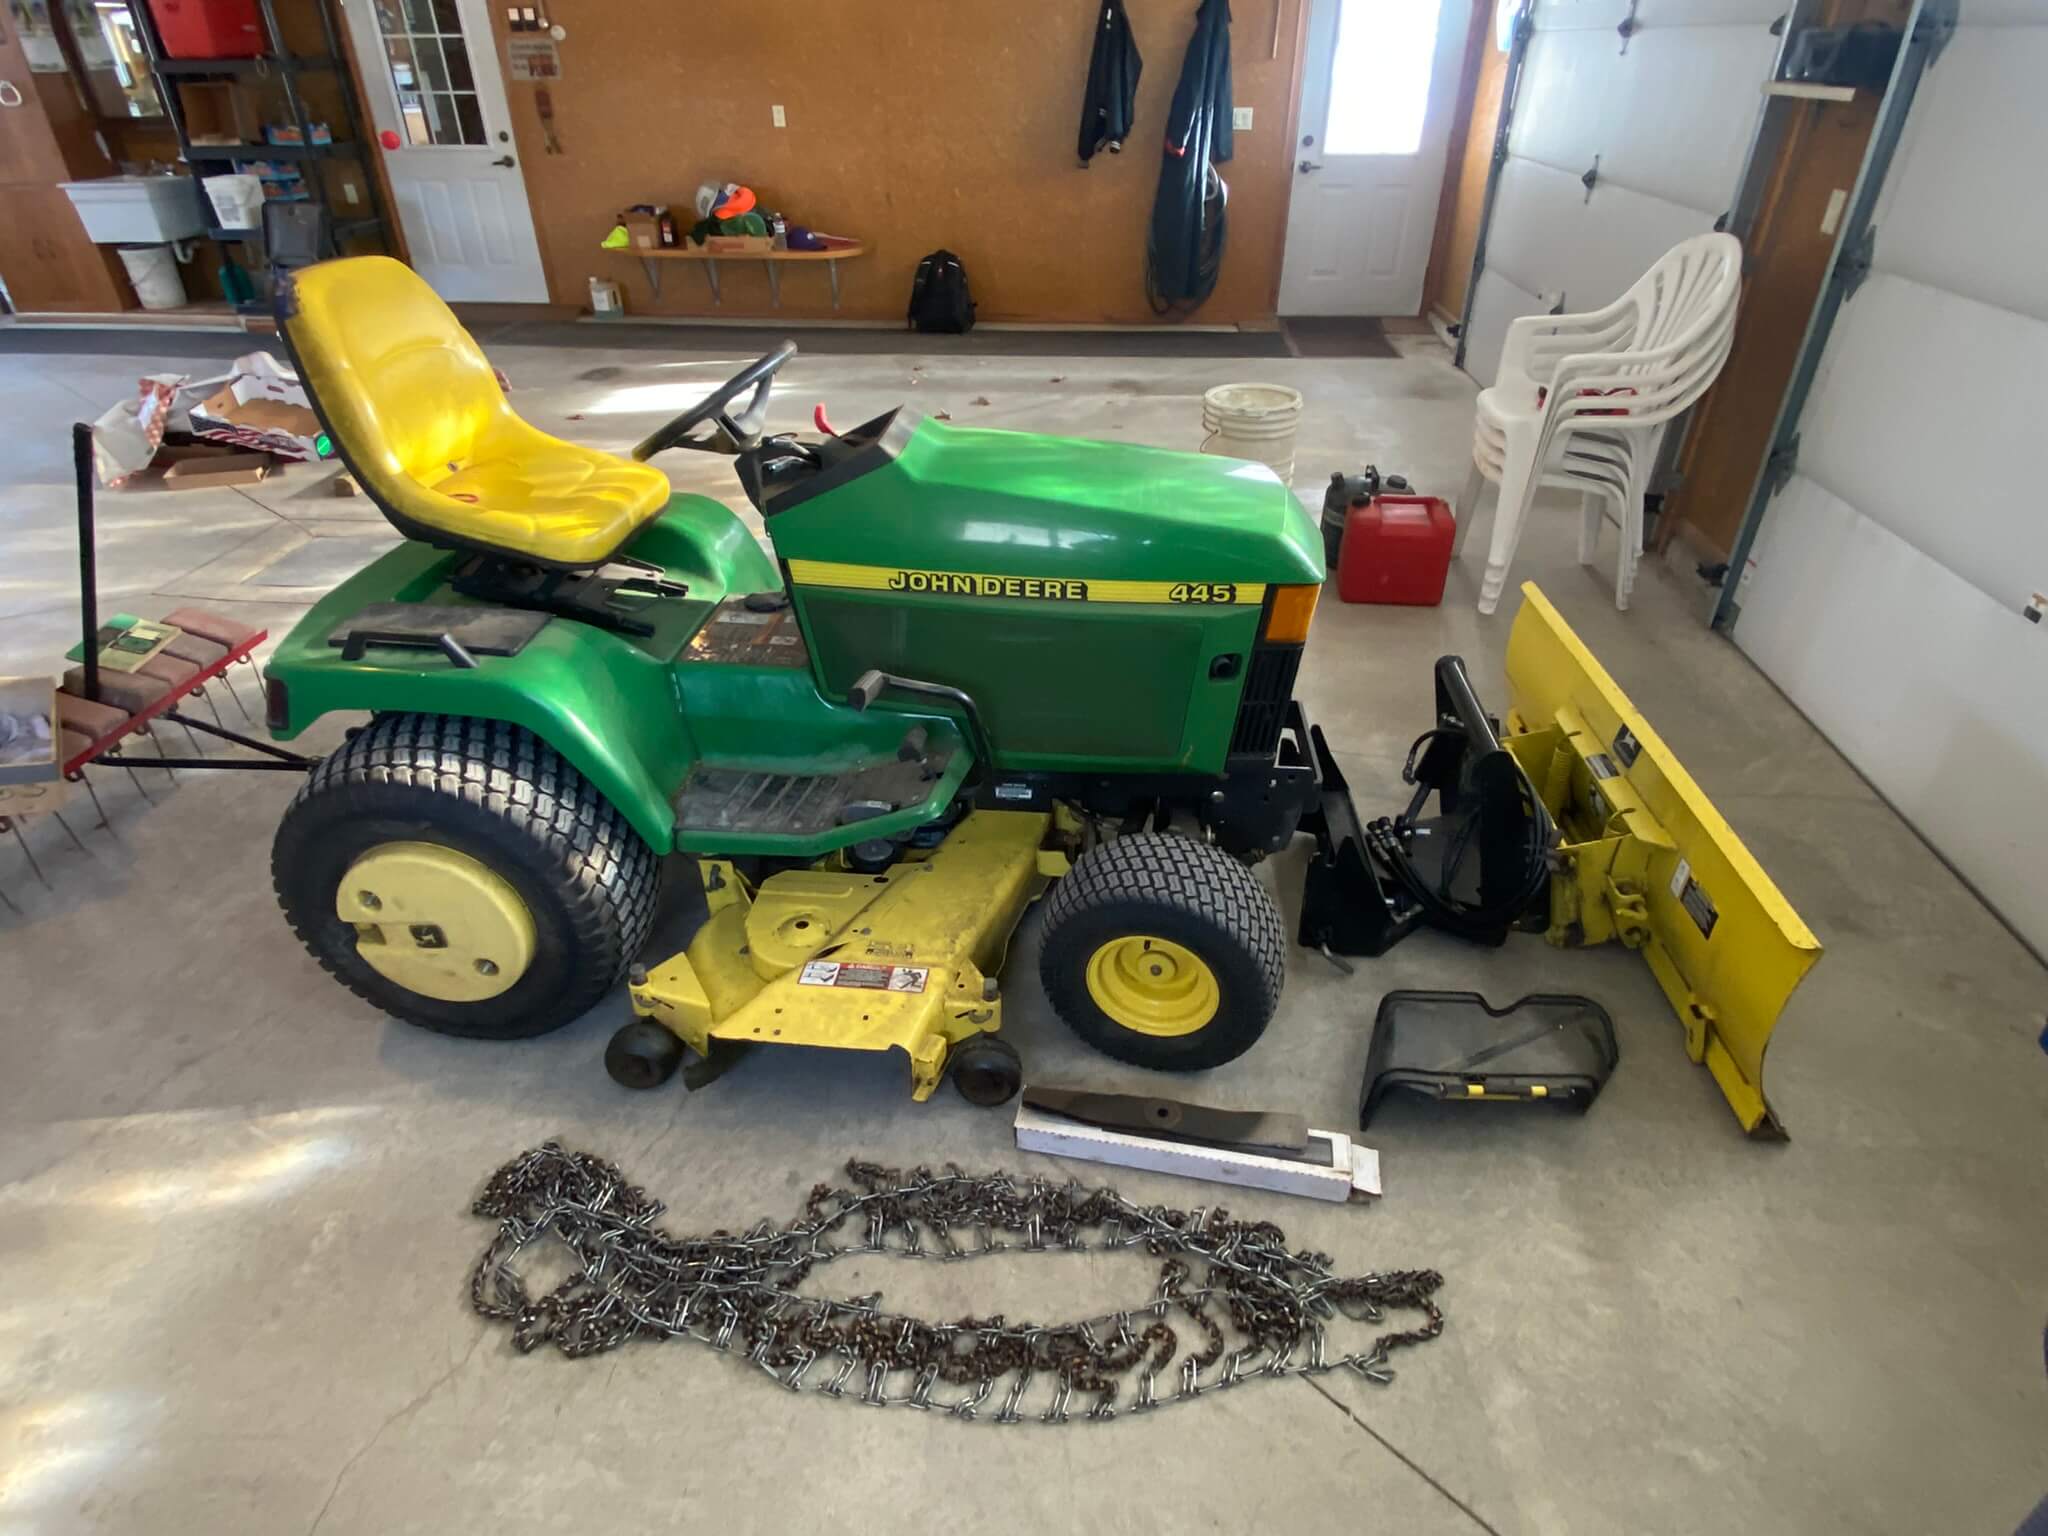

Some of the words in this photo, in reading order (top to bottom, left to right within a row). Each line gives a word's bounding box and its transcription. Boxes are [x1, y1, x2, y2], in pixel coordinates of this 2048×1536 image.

[889, 571, 973, 594] JOHN
[983, 577, 1086, 600] DEERE
[1169, 583, 1235, 603] 445
